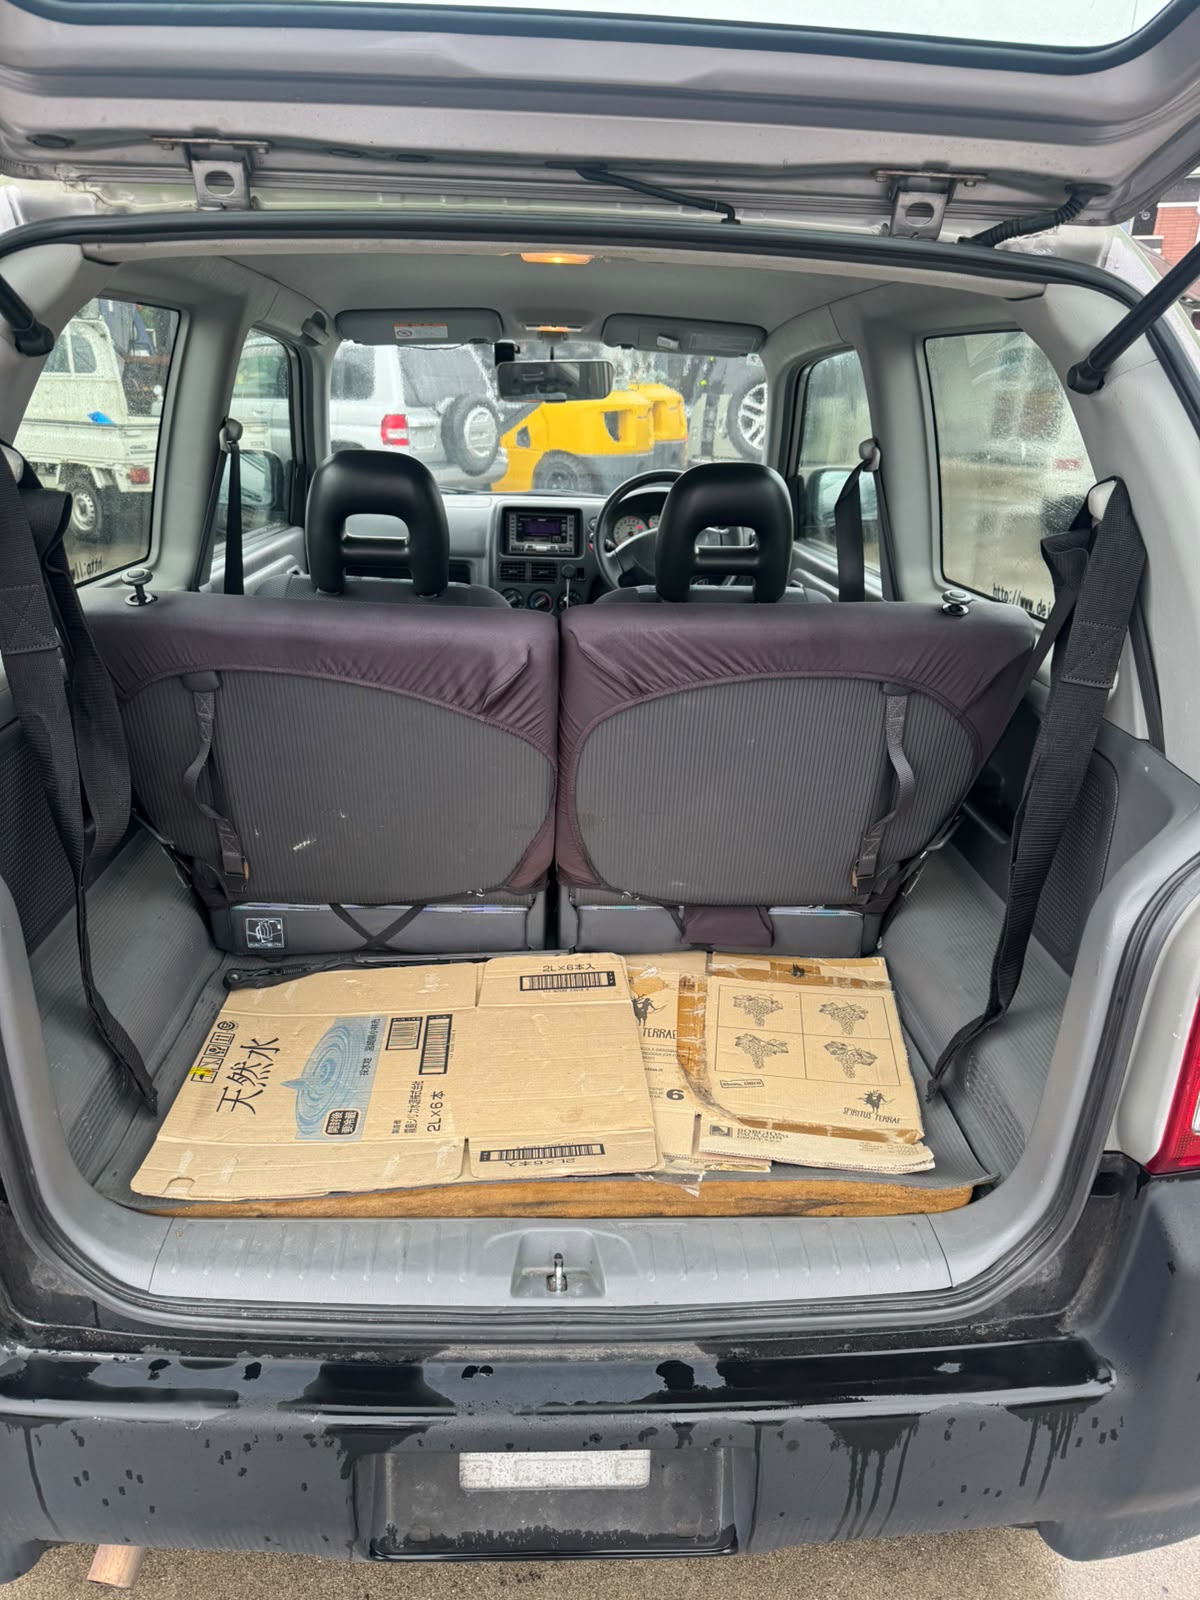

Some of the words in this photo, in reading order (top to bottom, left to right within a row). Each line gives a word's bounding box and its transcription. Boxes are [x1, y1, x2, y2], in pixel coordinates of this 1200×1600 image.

[216, 1037, 281, 1115] 天然水
[666, 1088, 685, 1101] 6
